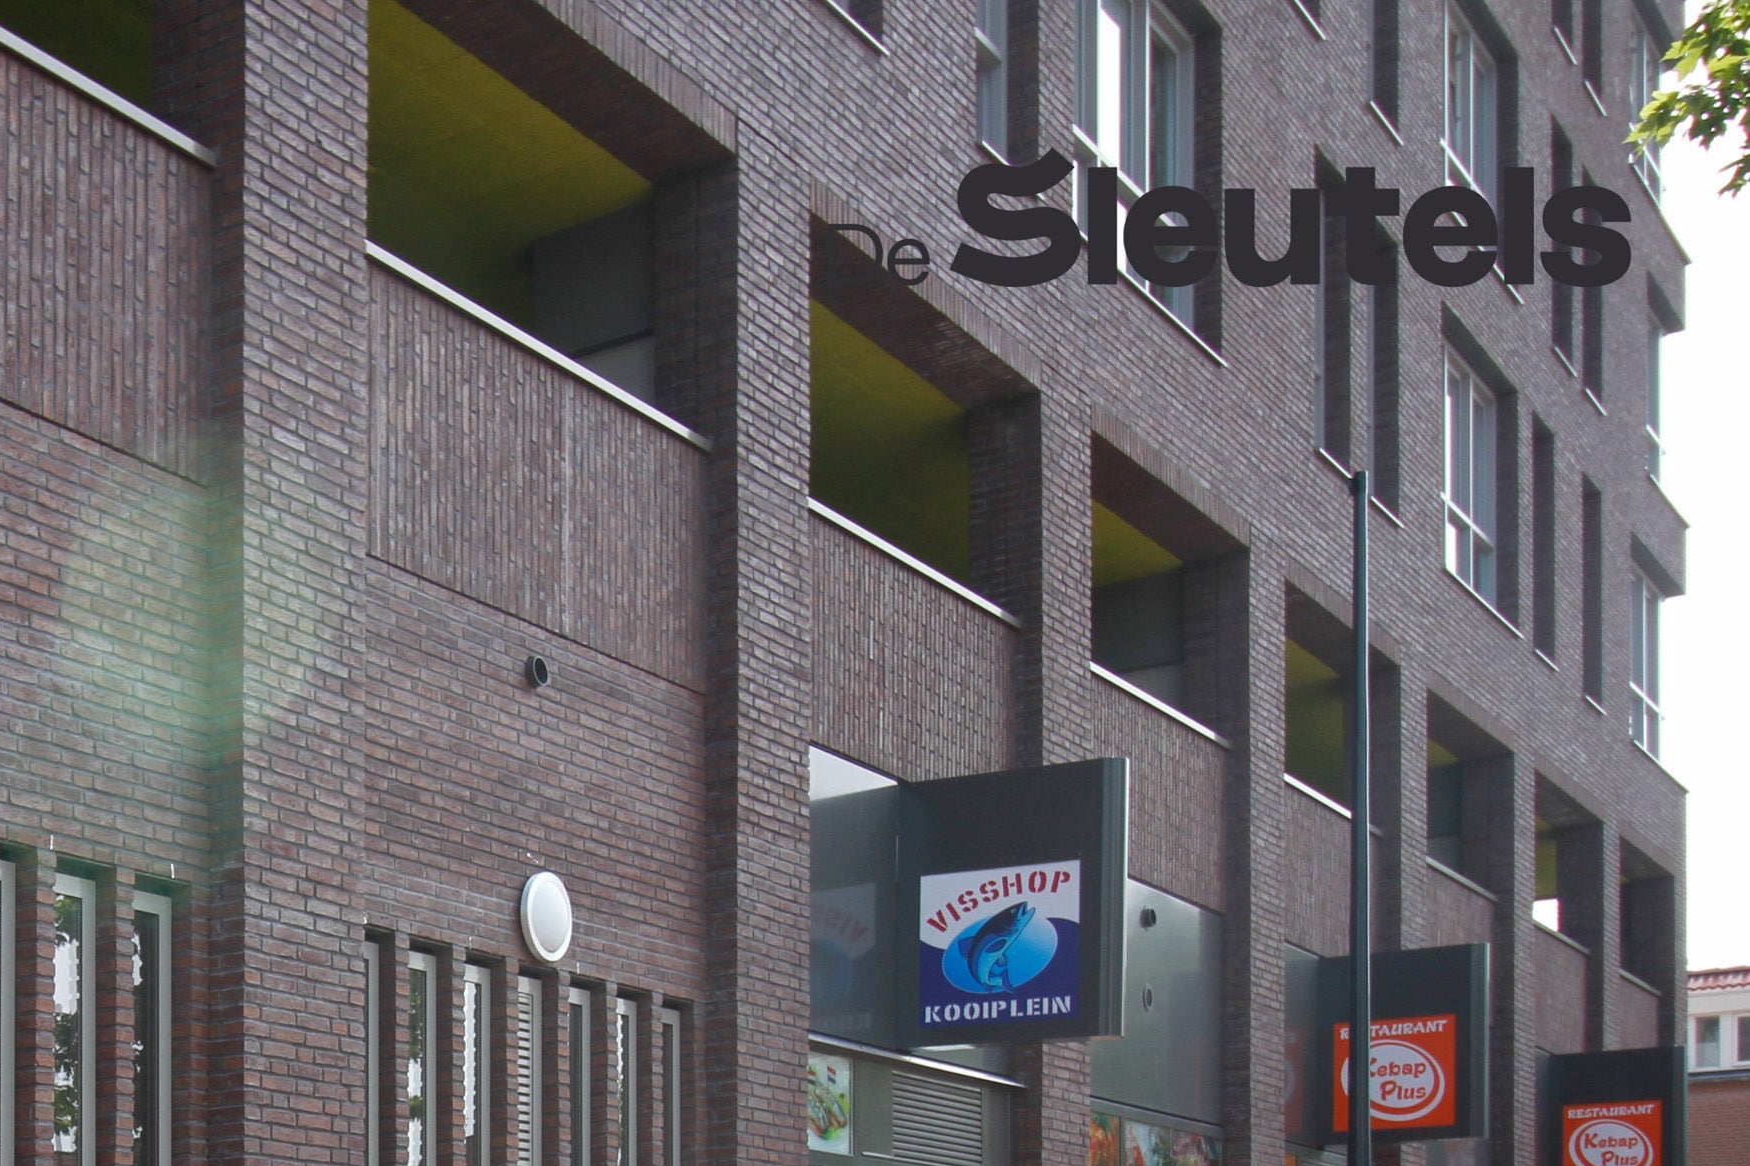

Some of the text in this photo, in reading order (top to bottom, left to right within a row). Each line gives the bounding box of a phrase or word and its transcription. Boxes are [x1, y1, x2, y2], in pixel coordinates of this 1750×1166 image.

[926, 870, 1071, 934] VISSHOP
[924, 995, 1071, 1024] KOOIPLEIN
[1340, 1019, 1447, 1041] RTAURANT
[1380, 1080, 1428, 1101] Plus
[1567, 1103, 1655, 1119] RESTAURANT
[1584, 1132, 1638, 1149] Kebap
[1601, 1150, 1638, 1166] Plus
